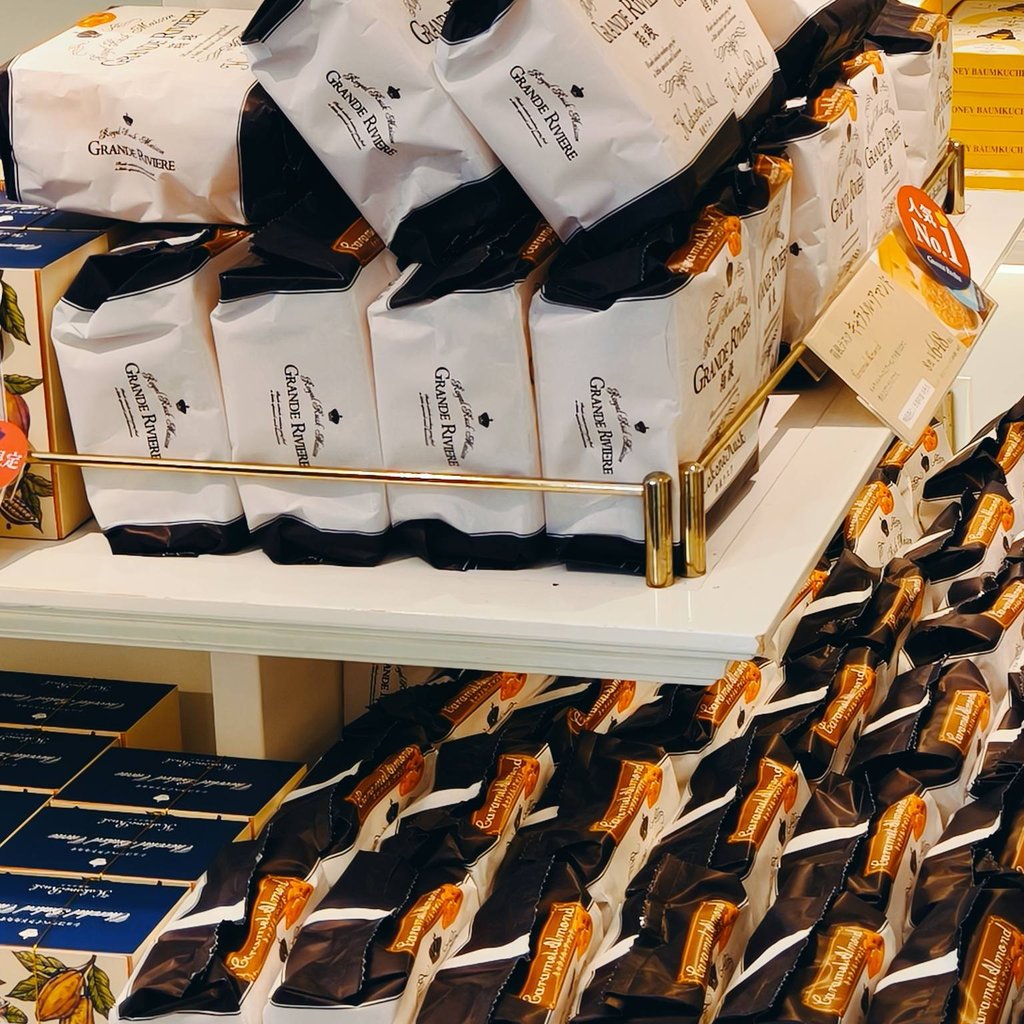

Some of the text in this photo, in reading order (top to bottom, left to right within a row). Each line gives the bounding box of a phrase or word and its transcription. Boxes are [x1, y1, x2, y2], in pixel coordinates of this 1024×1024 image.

[591, 9, 634, 44] GRANDE
[325, 70, 368, 118] GRANDE
[509, 65, 549, 115] GRANDE
[953, 67, 970, 76] NEY
[952, 106, 974, 115] ONEY
[88, 140, 137, 158] GRANDE
[911, 217, 963, 268] No.1
[124, 362, 149, 412] GRANDE
[284, 364, 301, 419] GRANDE
[434, 366, 451, 420] GRANDE
[589, 376, 607, 428] GRANDE
[28, 883, 63, 895] Rusk
